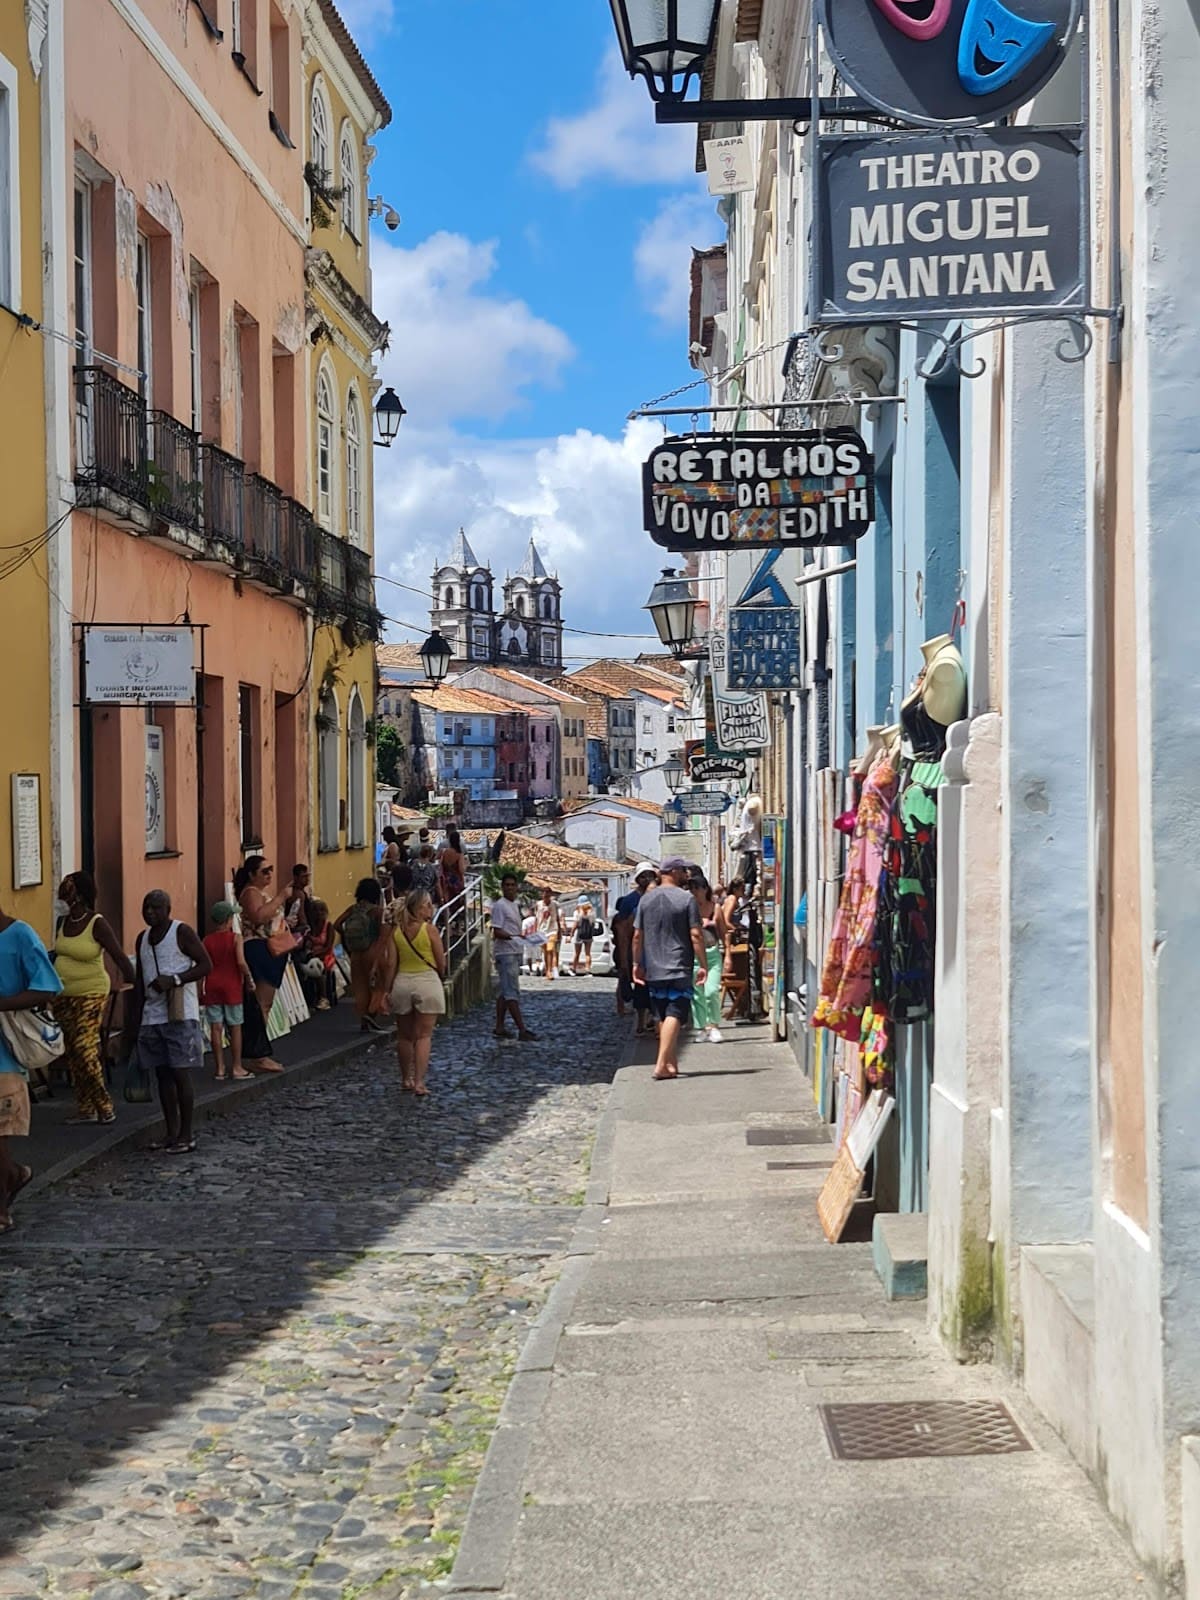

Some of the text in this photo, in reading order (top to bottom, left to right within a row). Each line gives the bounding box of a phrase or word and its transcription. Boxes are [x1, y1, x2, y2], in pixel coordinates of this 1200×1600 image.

[859, 149, 1041, 192] THEATRO
[848, 195, 1050, 249] MIGUEL
[845, 249, 1055, 302] SANTANA
[652, 443, 861, 483] RETALHOS
[651, 488, 869, 541] VOVO EDITH
[737, 482, 771, 508] DA
[722, 697, 760, 719] FILHOS
[735, 717, 751, 726] DE
[721, 719, 765, 743] GANDHY
